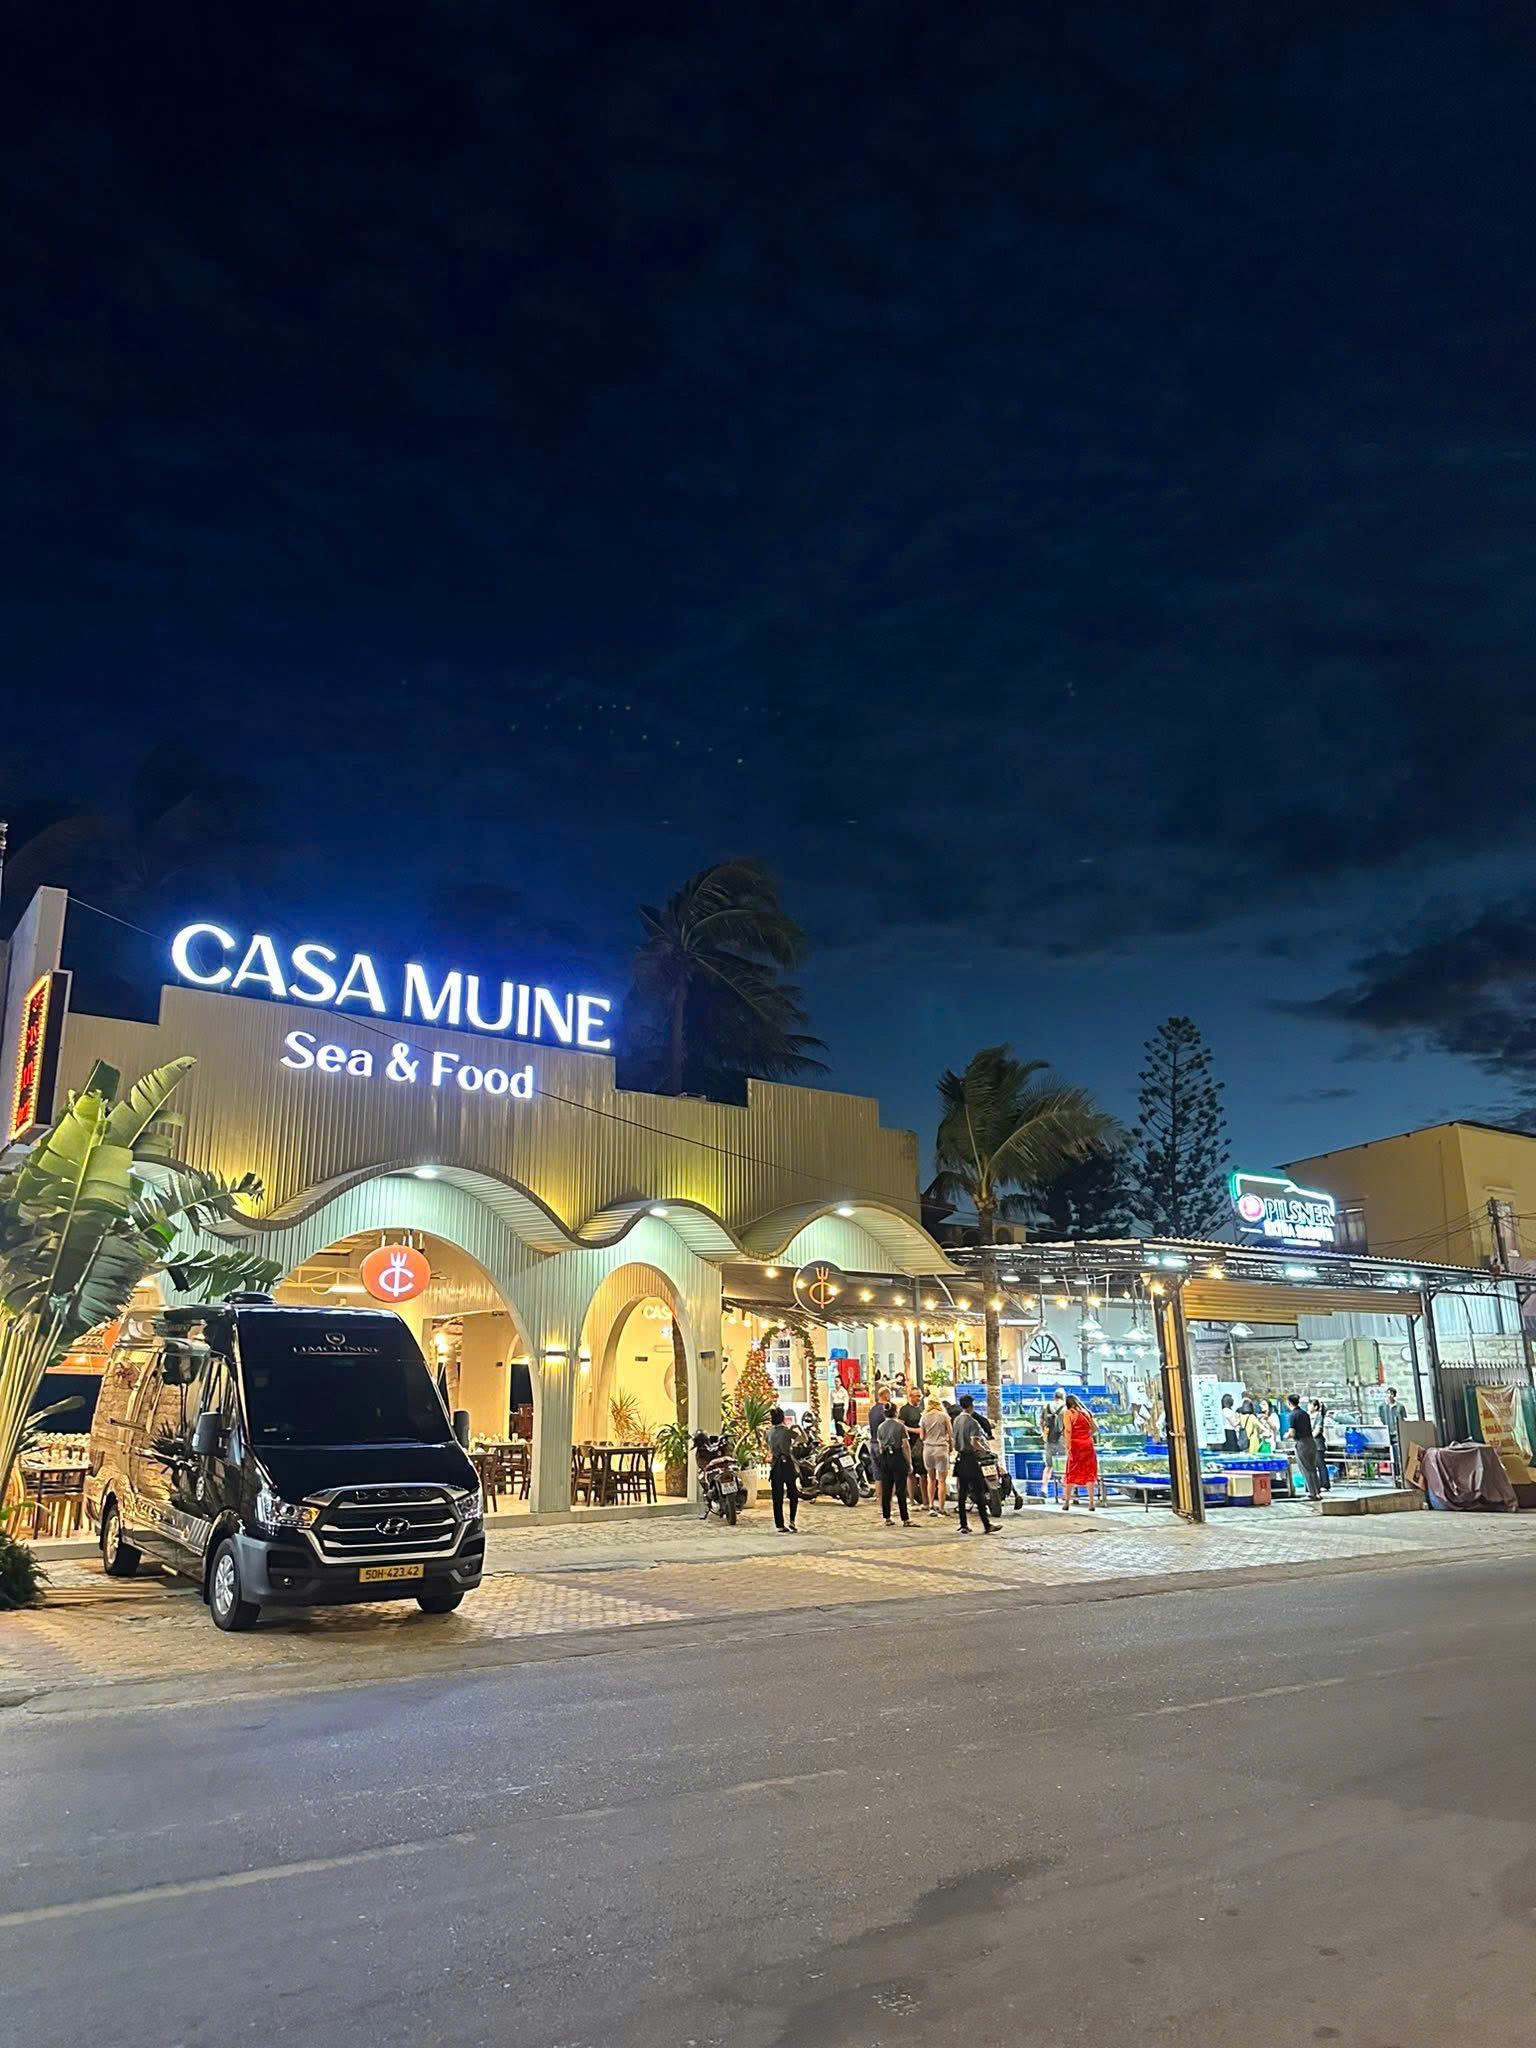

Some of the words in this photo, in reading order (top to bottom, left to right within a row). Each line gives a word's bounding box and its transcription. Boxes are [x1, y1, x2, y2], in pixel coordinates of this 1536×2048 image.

[171, 923, 386, 1013] CASA
[403, 963, 611, 1049] MUINE
[279, 1030, 373, 1077] Sea
[385, 1042, 419, 1083] &
[431, 1051, 534, 1100] Food
[1263, 1197, 1335, 1227] PILSNER
